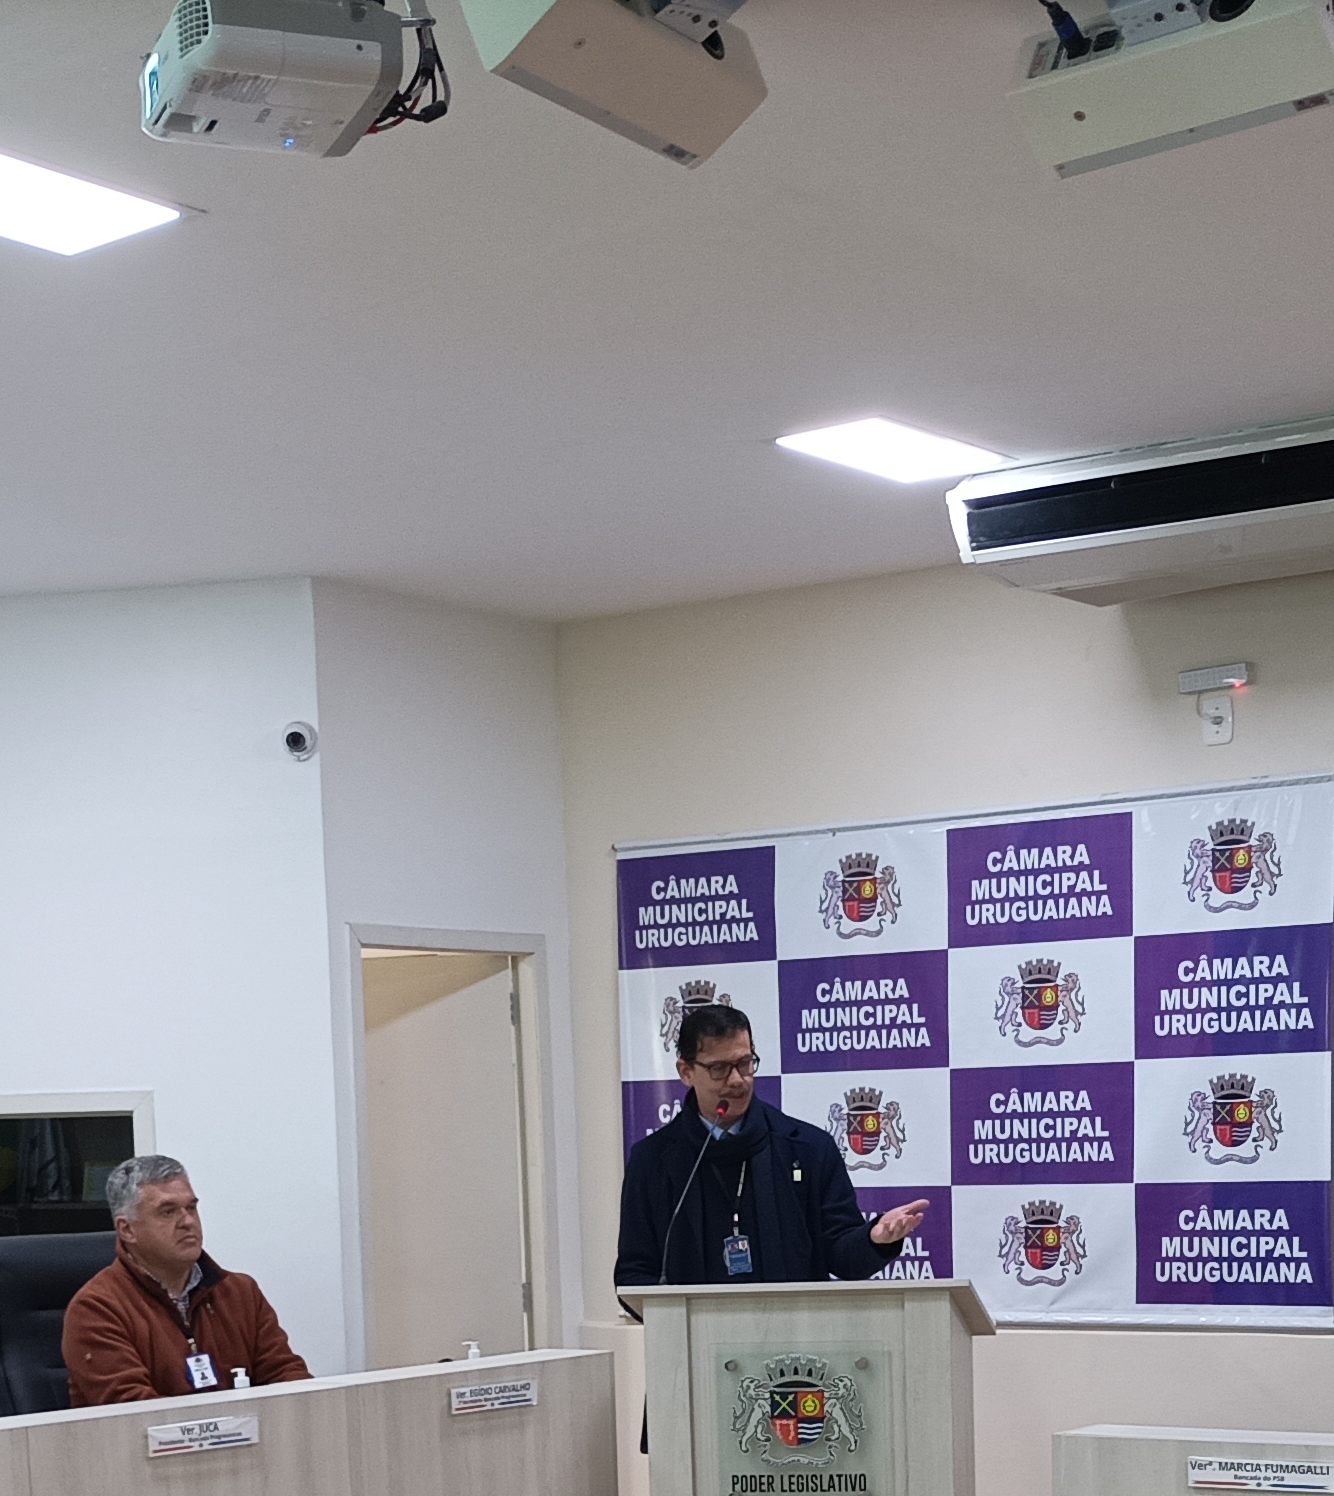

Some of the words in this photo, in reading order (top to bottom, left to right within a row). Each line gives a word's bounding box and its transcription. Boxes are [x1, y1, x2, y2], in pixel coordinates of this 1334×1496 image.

[986, 843, 1091, 873] CÂMARA
[651, 874, 739, 900] CÂMARA
[970, 869, 1108, 901] MUNICIPAL
[638, 898, 754, 926] MUNICIPAL
[965, 894, 1113, 926] URUGUAIANA
[635, 921, 759, 949] URUGUAIANA
[1177, 954, 1290, 983] CÂMARA
[816, 977, 910, 1003] CÂMARA
[1160, 981, 1309, 1011] MUNICIPAL
[801, 1003, 926, 1029] MUNICIPAL
[1154, 1007, 1315, 1037] URUGUAIANA
[796, 1027, 931, 1053] URUGUAIANA
[989, 1087, 1093, 1114] CÂMARA
[973, 1116, 1110, 1140] MUNICIPAL
[968, 1141, 1115, 1165] URUGUAIANA
[1178, 1204, 1290, 1231] CÂMARA
[1161, 1236, 1308, 1258] MUNICIPAL
[1155, 1261, 1313, 1284] URUGUAIANA
[1264, 1463, 1330, 1476] FUMAGALLI
[731, 1474, 775, 1493] PODER
[780, 1473, 867, 1493] LEGISLATIVO
